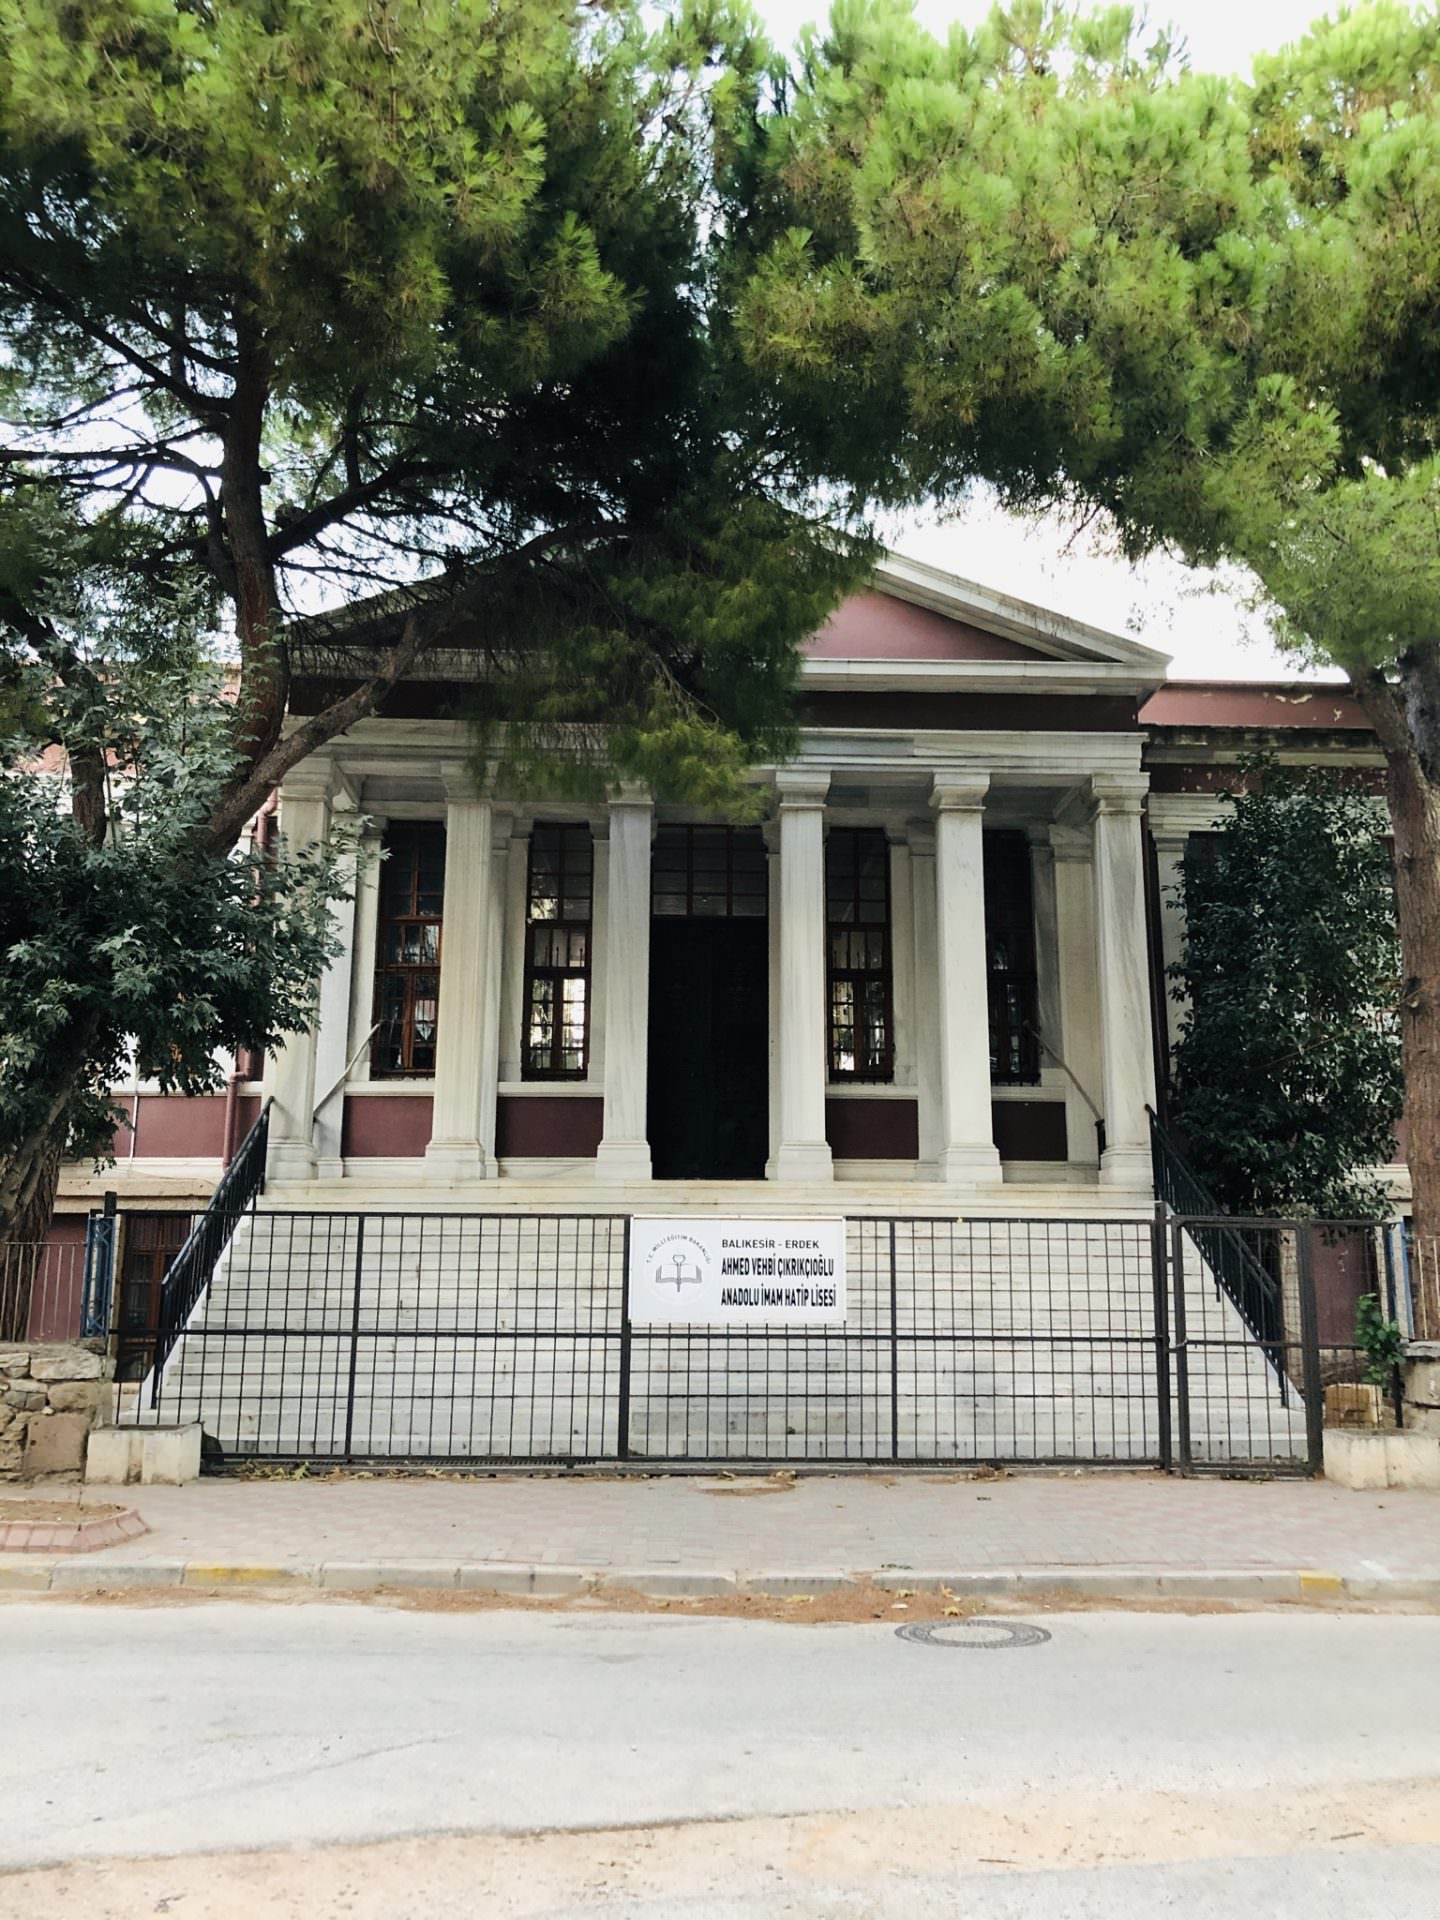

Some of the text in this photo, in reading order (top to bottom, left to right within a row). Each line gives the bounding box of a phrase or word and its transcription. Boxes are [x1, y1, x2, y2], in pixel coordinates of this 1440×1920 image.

[722, 1237, 775, 1249] BALIKESİR
[785, 1240, 820, 1249] ERDEK
[721, 1253, 834, 1279] AHMED VEHBİ ÇIKRIKÇIOĞLU
[721, 1283, 836, 1307] ANADOLU İMAM HATİP LİSESİ
